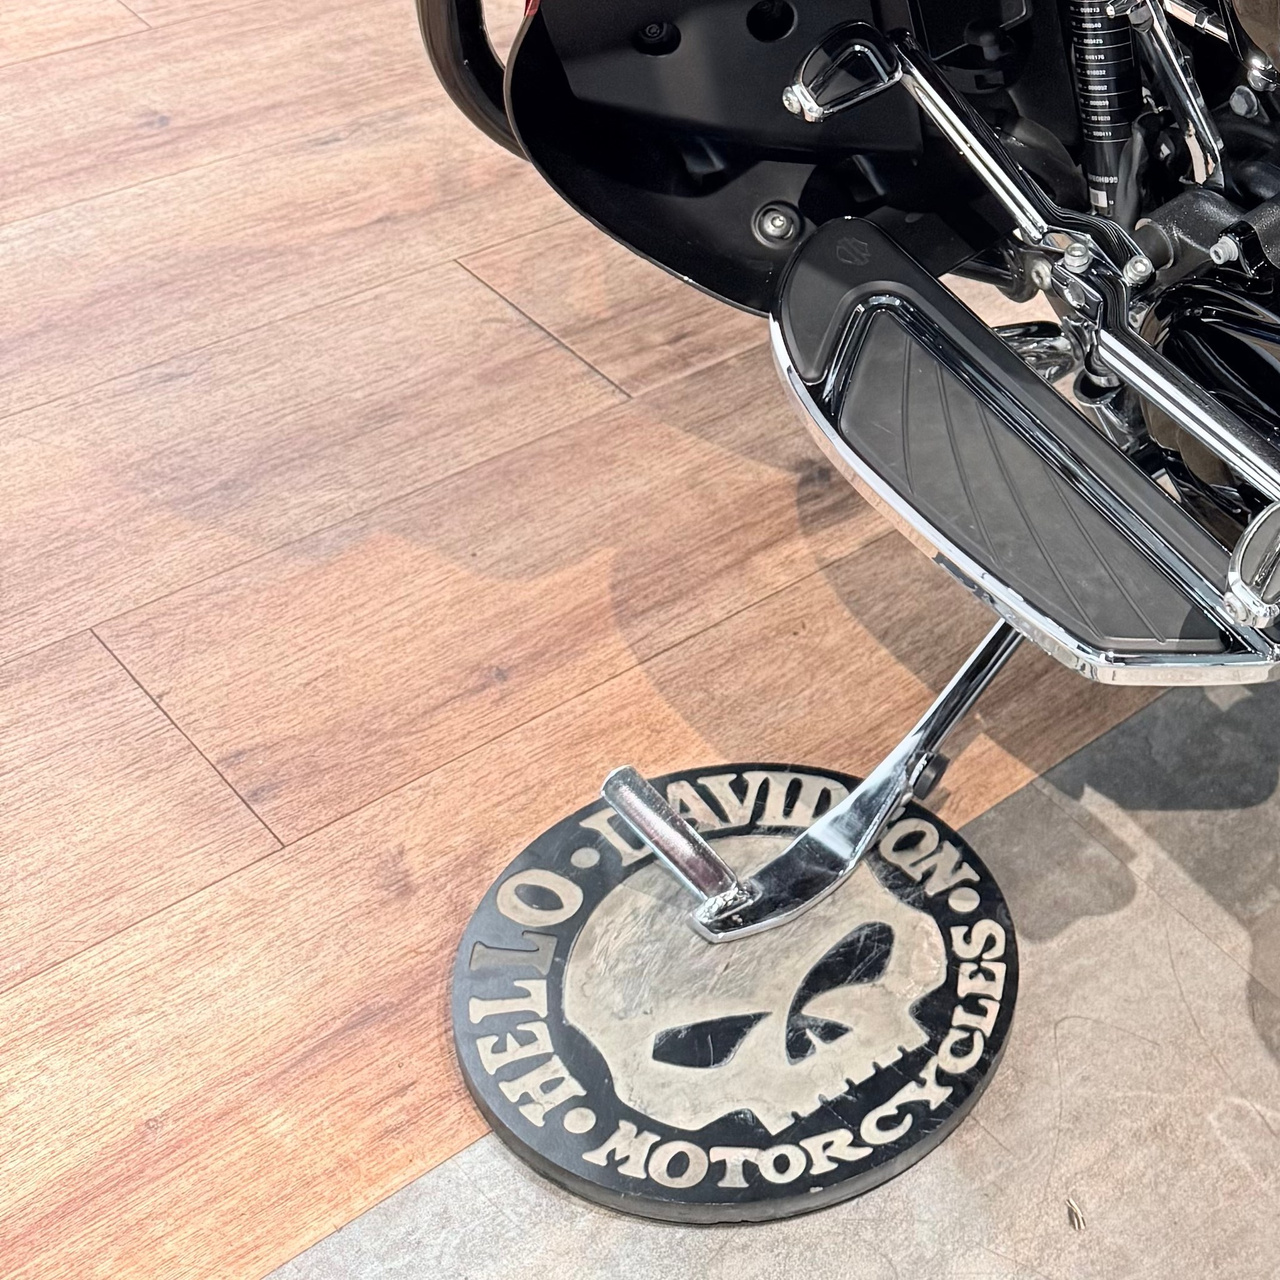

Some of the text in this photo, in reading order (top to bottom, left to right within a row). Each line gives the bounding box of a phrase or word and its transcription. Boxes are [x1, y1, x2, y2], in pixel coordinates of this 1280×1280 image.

[469, 770, 981, 1127] HELLO DAVIDON
[583, 919, 1006, 1188] MOTORCYCLES
